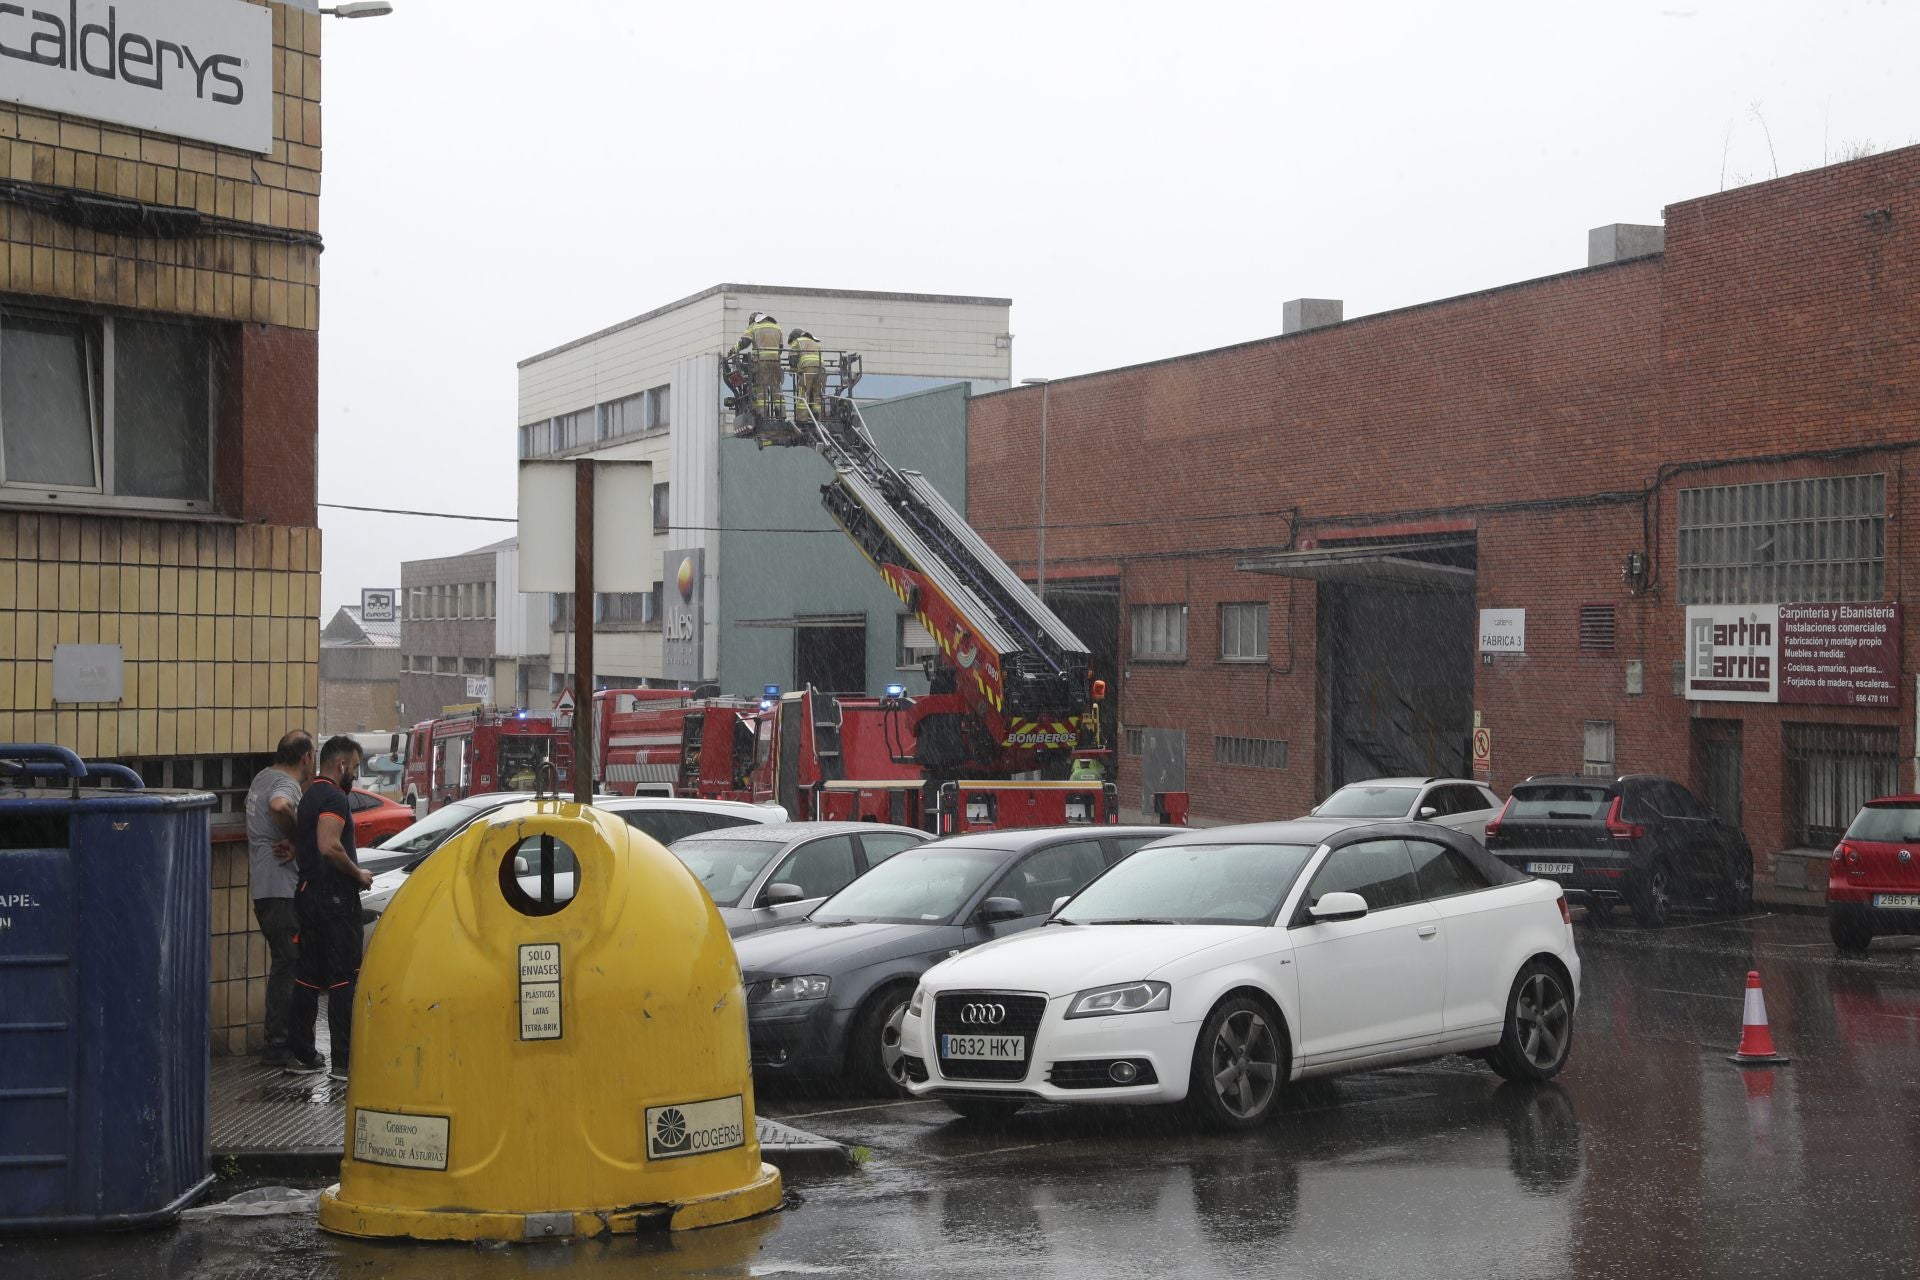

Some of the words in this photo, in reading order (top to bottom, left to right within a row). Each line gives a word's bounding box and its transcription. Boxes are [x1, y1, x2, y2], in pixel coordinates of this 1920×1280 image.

[1831, 609, 1838, 621] y
[666, 606, 693, 640] Ales
[1785, 622, 1836, 632] Instalaciones
[1838, 623, 1887, 632] comerciales
[1517, 636, 1522, 646] 3
[1785, 636, 1823, 645] Fabricación
[1824, 638, 1829, 647] y
[1830, 637, 1858, 647] montaje
[1859, 636, 1882, 647] propio
[1784, 649, 1812, 657] Muebles
[1819, 649, 1846, 658] medida:
[1787, 663, 1816, 673] Cocinas,
[1817, 664, 1849, 674] armarios,
[1787, 677, 1816, 687] Forjados
[1817, 678, 1826, 686] de
[1827, 679, 1854, 689] madera,
[1008, 732, 1077, 743] BOMBEROS
[1555, 864, 1572, 873] KPF
[1881, 896, 1907, 905] 2965
[1910, 896, 1920, 906] F
[528, 950, 551, 961] SOLO
[521, 964, 560, 976] ENVASES
[532, 1007, 549, 1016] LATAS
[524, 1023, 558, 1032] TETRA-BRIK
[950, 1038, 985, 1056] 0632
[990, 1038, 1020, 1057] HKY
[692, 1122, 742, 1149] COGERSA
